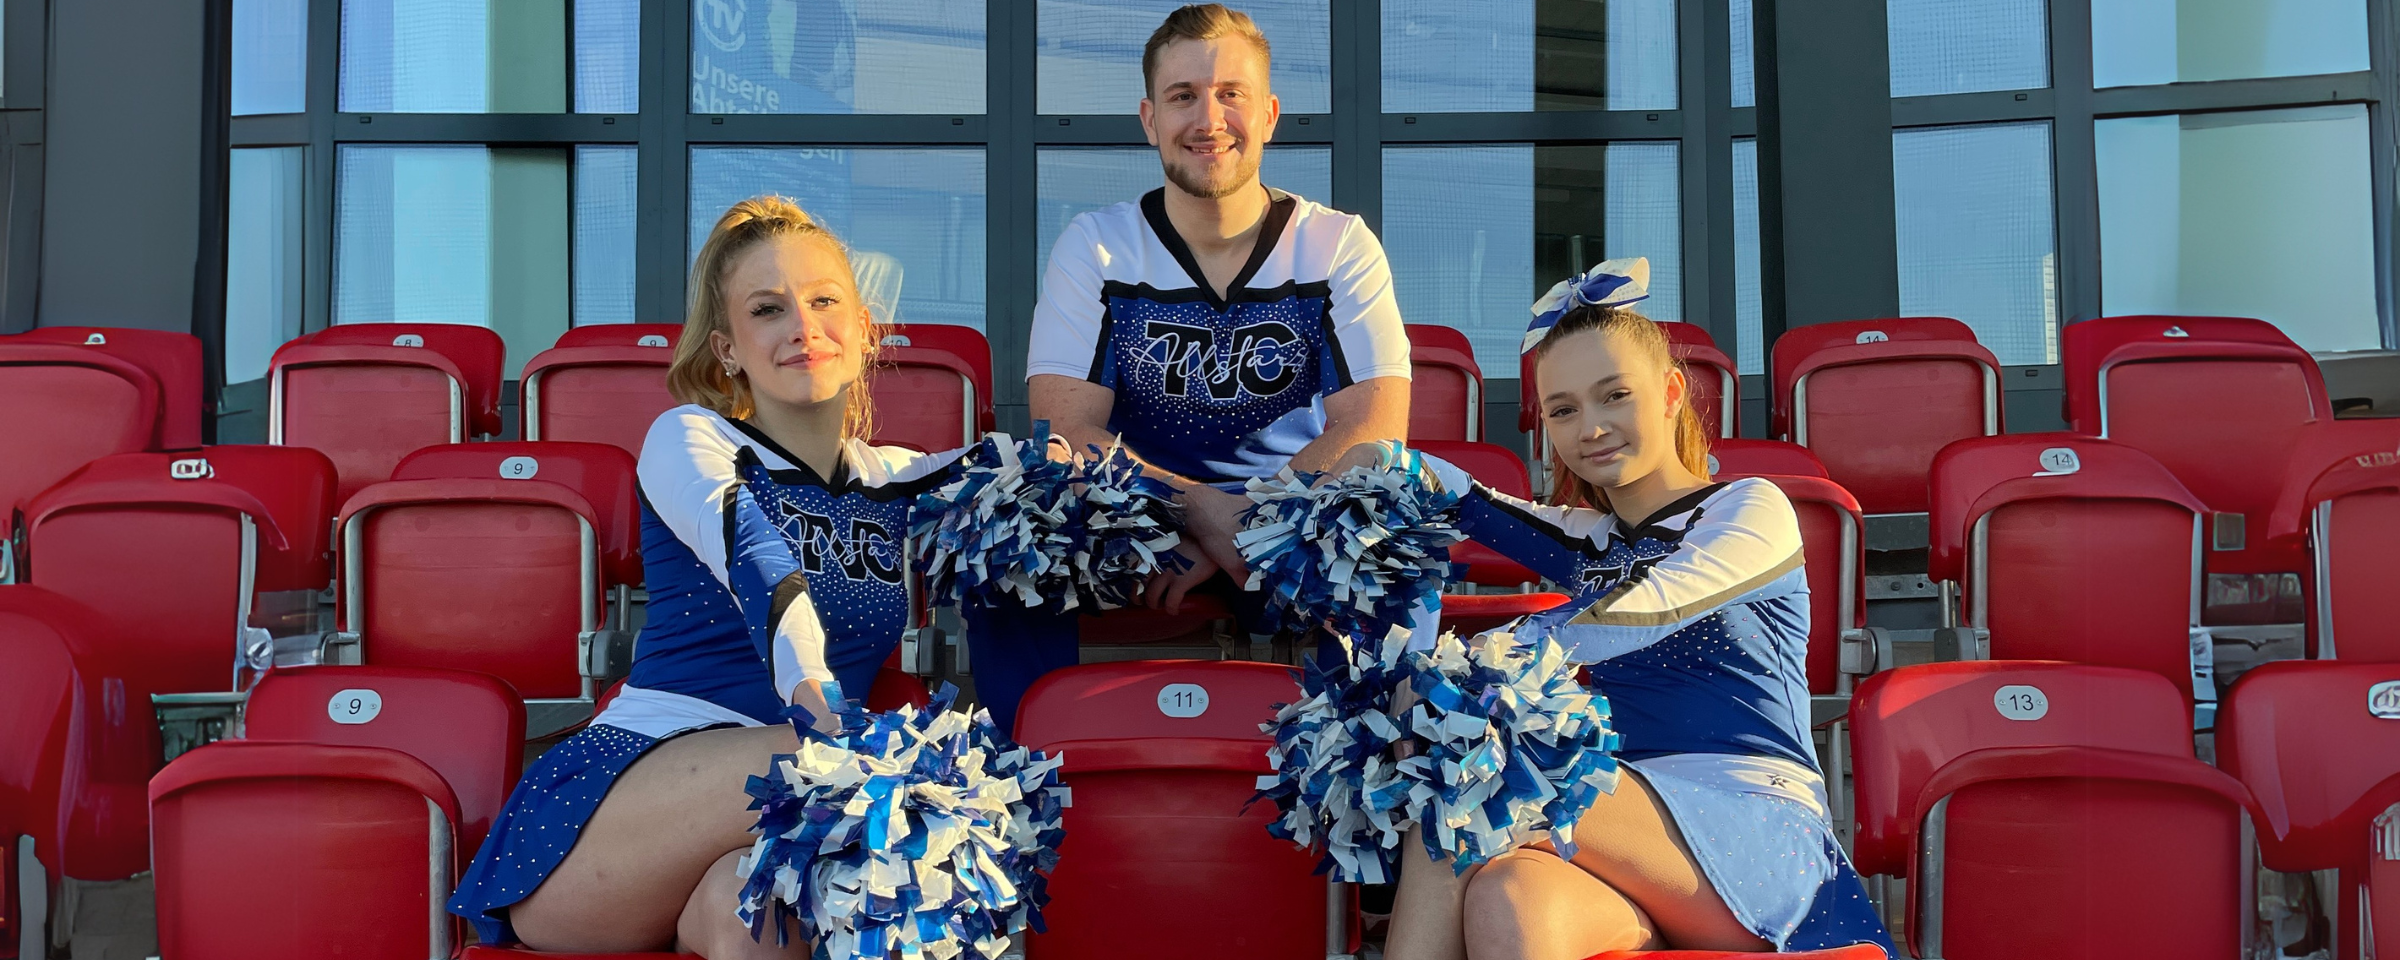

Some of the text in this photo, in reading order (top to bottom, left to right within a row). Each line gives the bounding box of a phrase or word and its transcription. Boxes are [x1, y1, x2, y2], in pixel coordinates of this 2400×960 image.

[693, 51, 781, 111] Unsere
[1129, 332, 1310, 385] Allstars
[1144, 319, 1300, 400] TVC
[513, 462, 524, 475] 9
[2052, 453, 2072, 466] 14
[348, 698, 362, 715] 9
[1174, 691, 1193, 708] 11
[2009, 693, 2035, 712] 13
